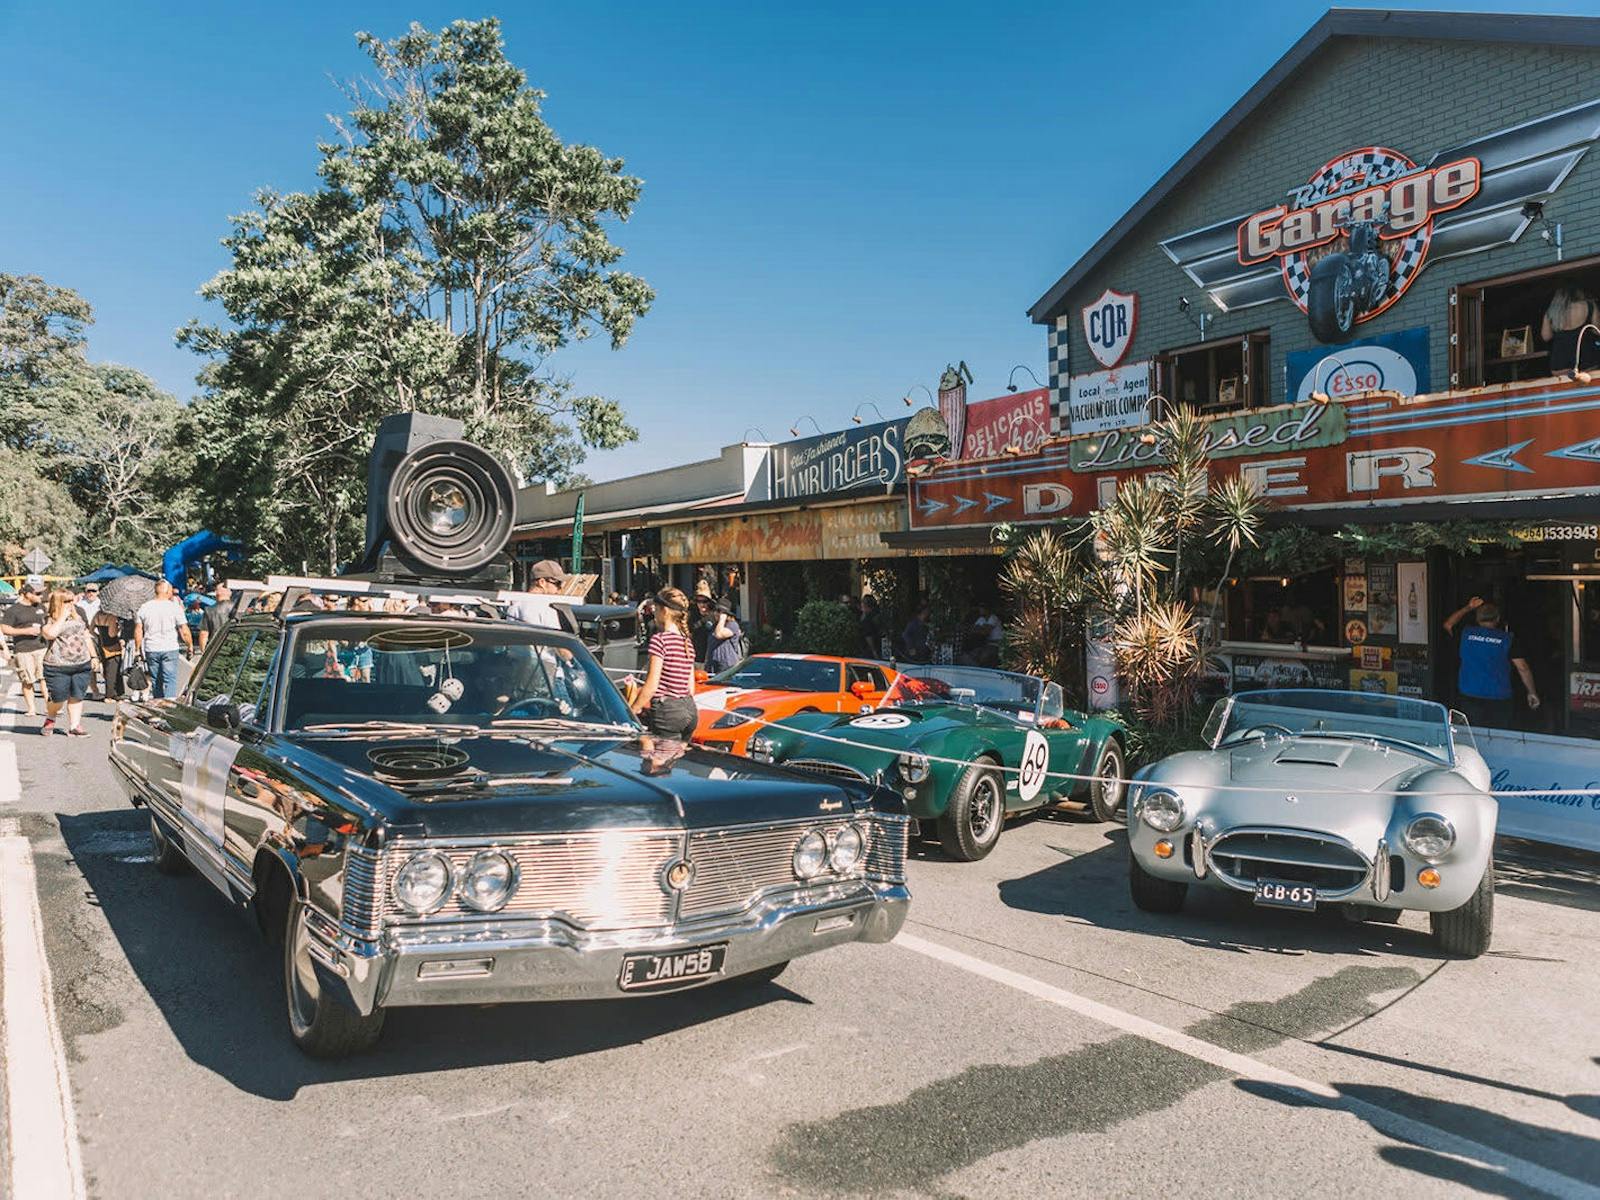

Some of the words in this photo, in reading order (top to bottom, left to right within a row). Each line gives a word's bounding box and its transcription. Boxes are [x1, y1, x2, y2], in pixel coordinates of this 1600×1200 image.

[1248, 160, 1478, 257] Garage
[1090, 303, 1127, 349] COR
[1079, 386, 1100, 398] Local
[1123, 377, 1148, 392] Agent
[1333, 372, 1378, 393] Esso
[967, 396, 1044, 451] DELICIOUS
[1070, 400, 1103, 422] VACUUM
[1104, 399, 1118, 418] OIL
[790, 455, 804, 470] Old
[804, 432, 847, 465] Fashioned
[1077, 402, 1327, 467] Licesed
[775, 425, 900, 499] HAMBURGERS
[1022, 743, 1046, 786] 69
